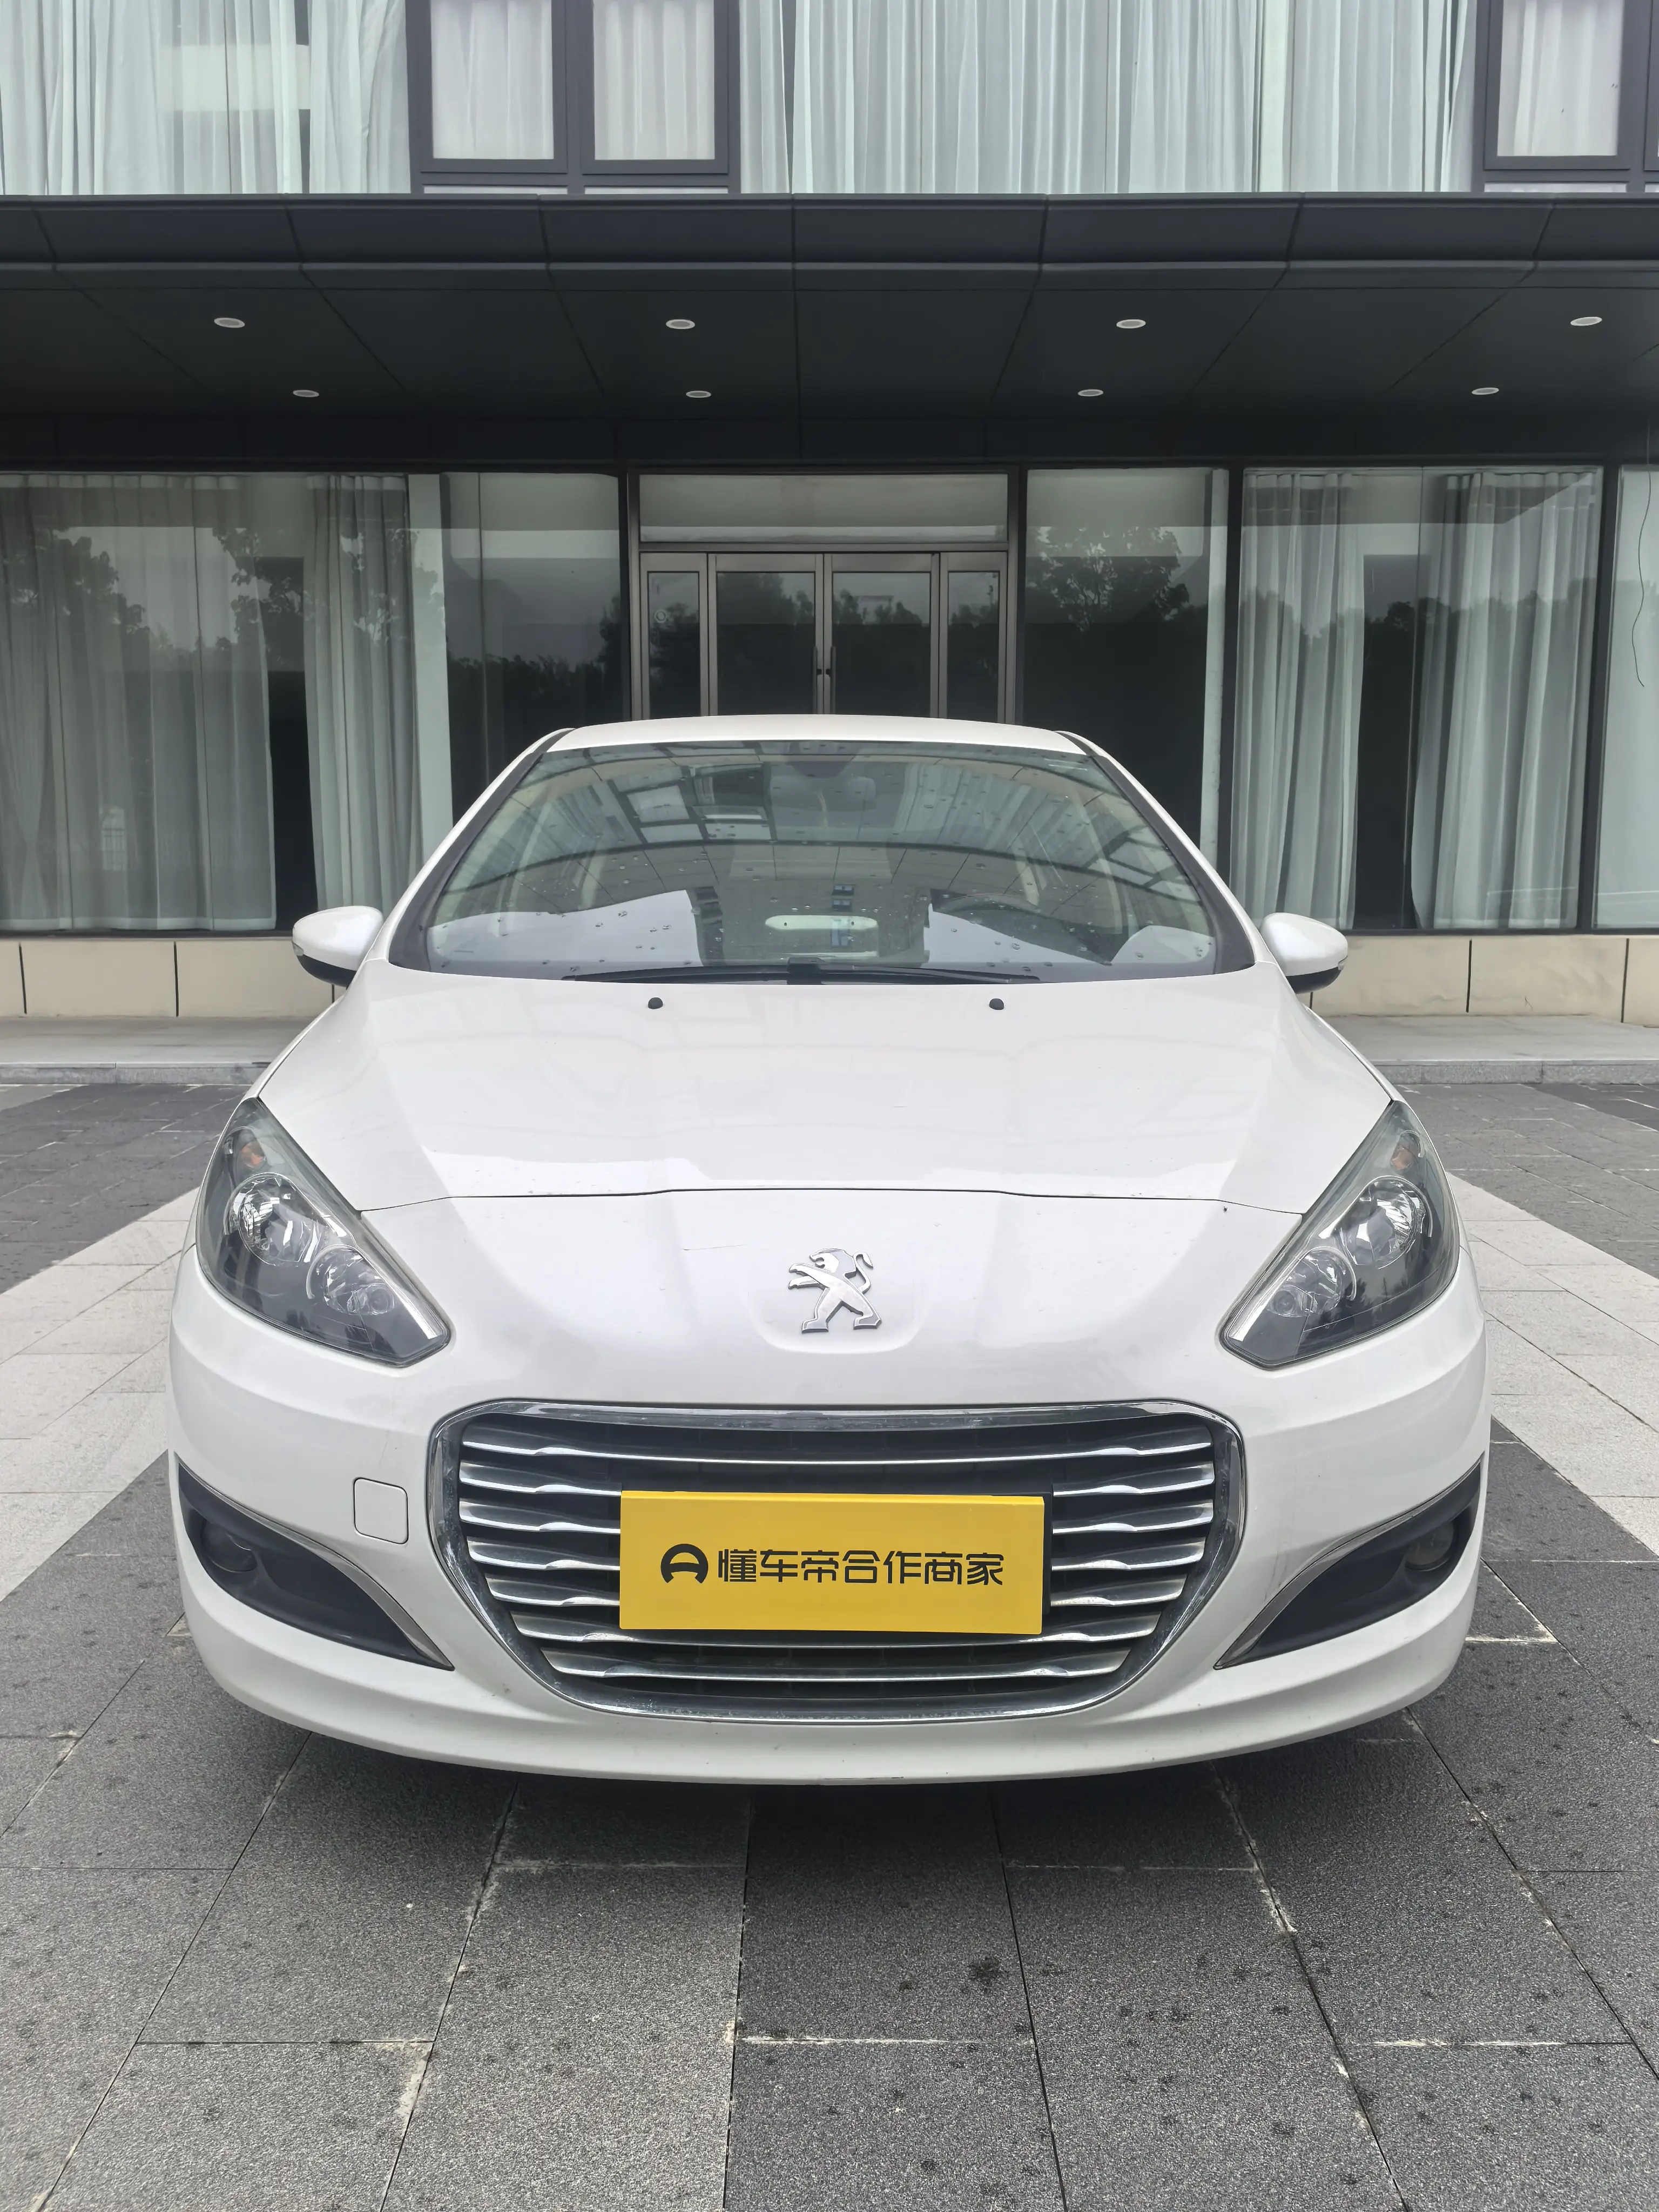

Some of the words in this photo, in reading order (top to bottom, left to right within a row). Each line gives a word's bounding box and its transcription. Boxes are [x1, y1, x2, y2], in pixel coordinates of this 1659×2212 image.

[718, 1548, 1004, 1586] 懂车帝合作商家
